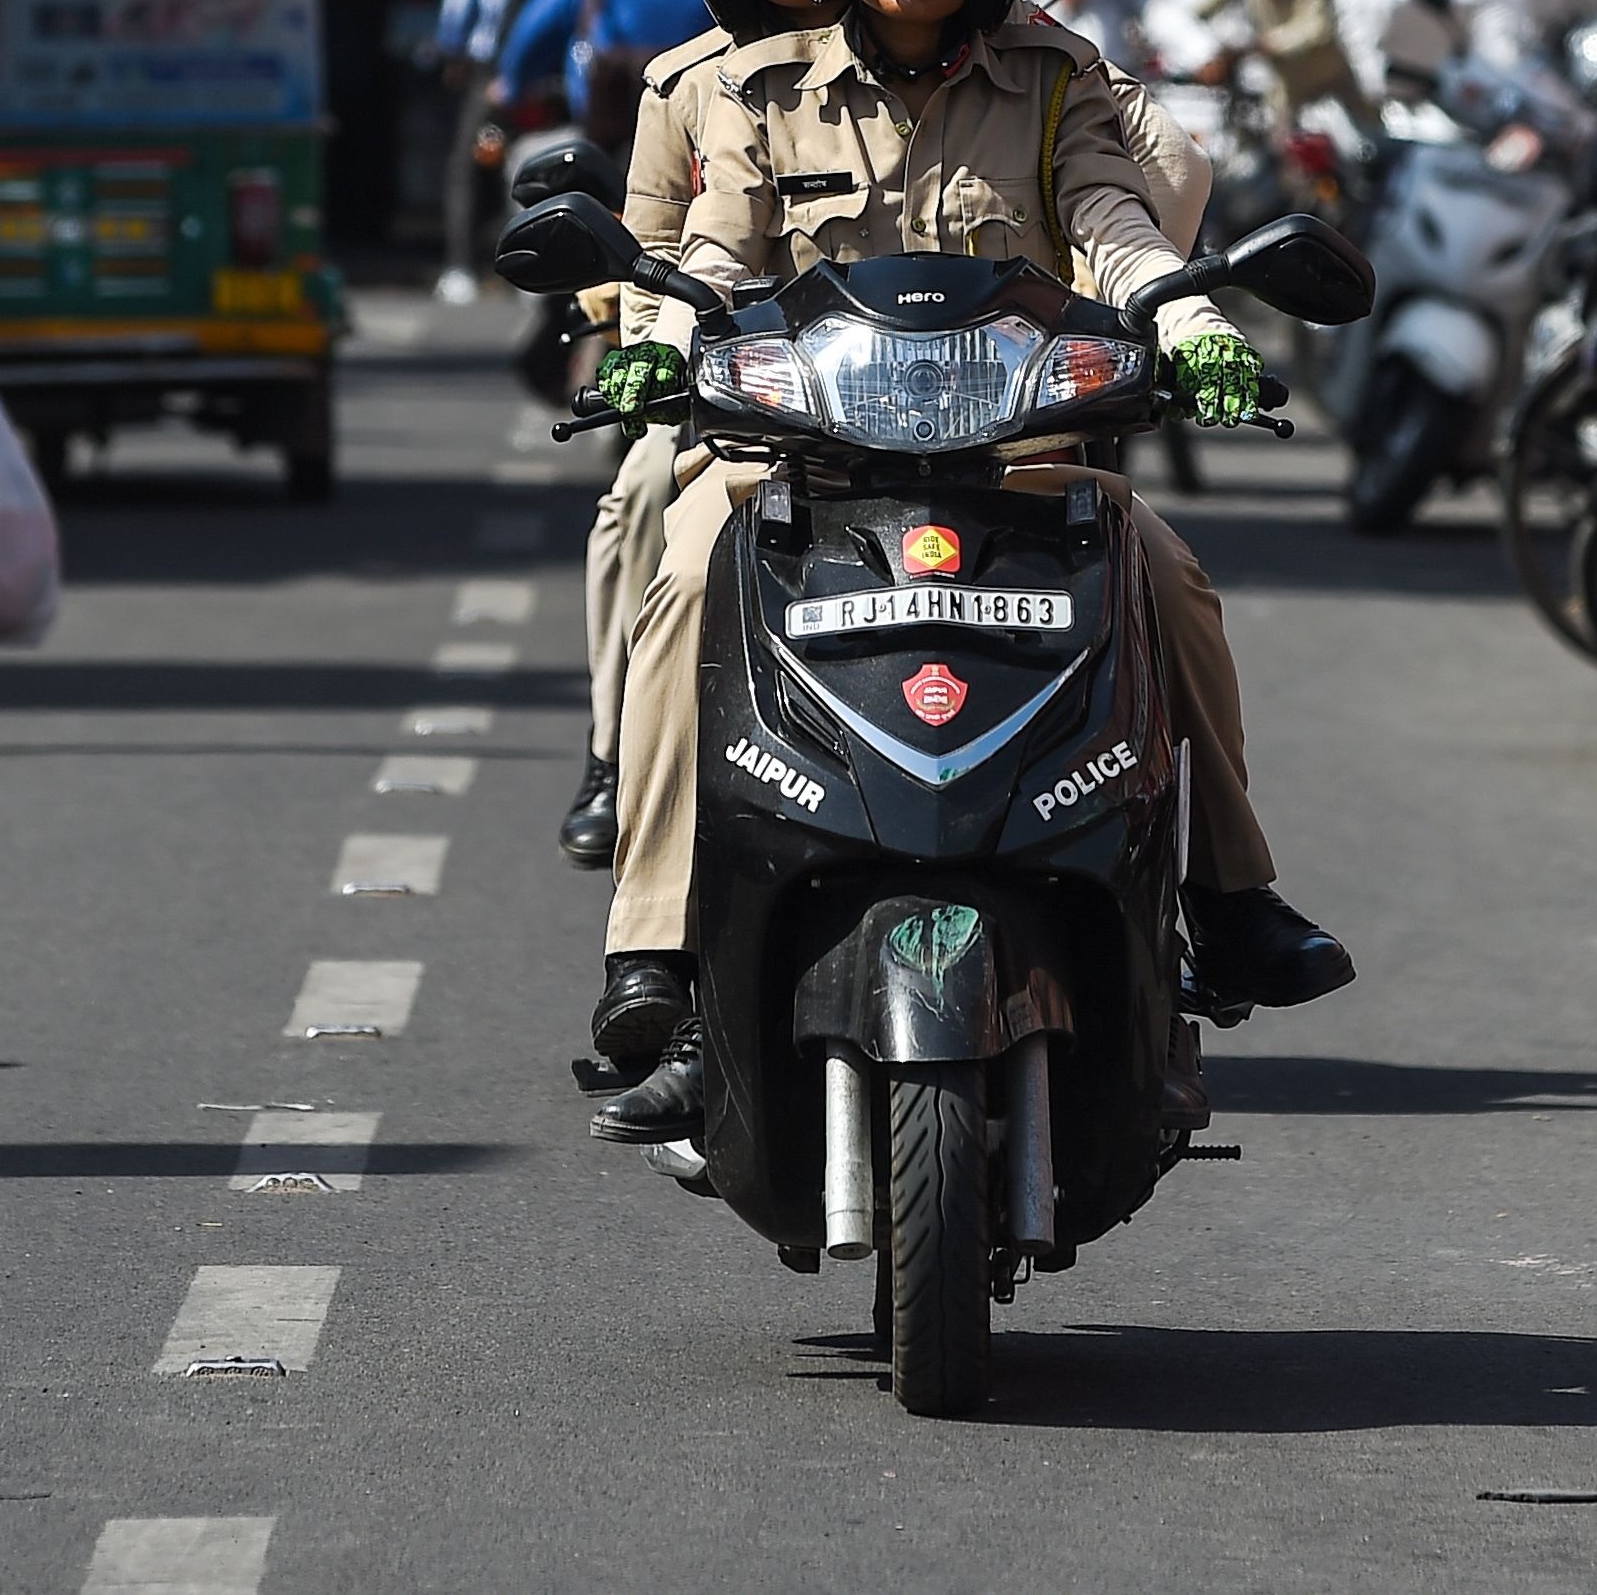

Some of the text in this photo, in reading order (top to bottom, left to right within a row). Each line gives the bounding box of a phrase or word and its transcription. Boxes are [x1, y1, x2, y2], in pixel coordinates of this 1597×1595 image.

[897, 292, 945, 305] Hero
[725, 737, 825, 813] JAIPUR
[1032, 740, 1138, 822] POLICE
